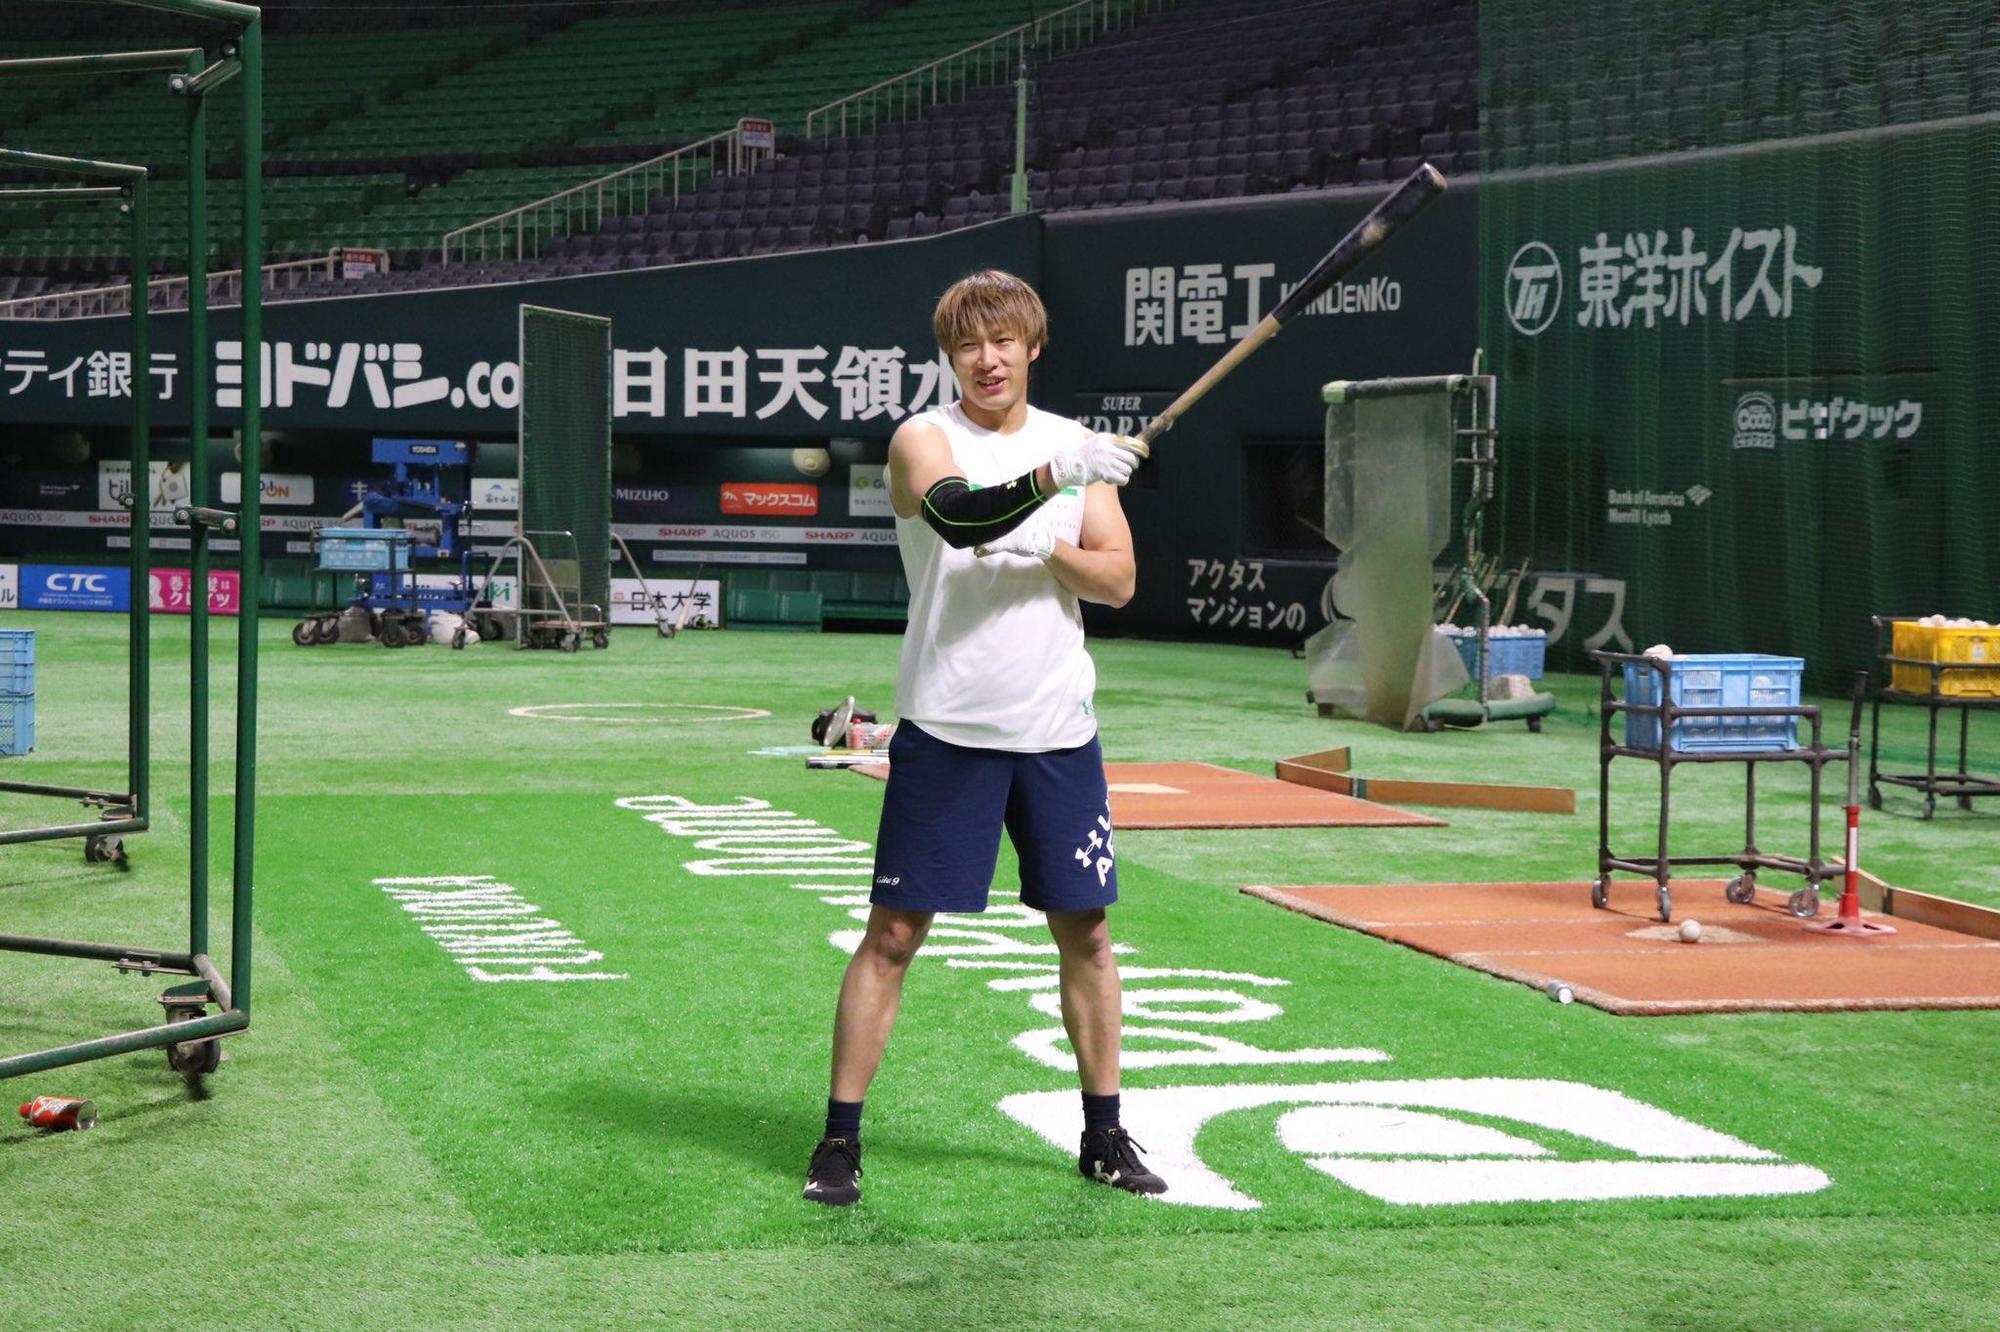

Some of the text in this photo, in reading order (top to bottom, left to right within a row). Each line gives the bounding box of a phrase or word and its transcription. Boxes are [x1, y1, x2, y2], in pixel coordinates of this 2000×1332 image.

[1577, 225, 1823, 328] 東洋ホイスト
[1125, 263, 1276, 346] 関電工
[613, 345, 962, 421] 日田天領水
[1102, 396, 1142, 411] SUPER
[1782, 396, 1923, 439] ピザクック
[615, 488, 669, 502] MIZUHO
[743, 492, 816, 508] マックスコム
[1608, 489, 1632, 504] Bank
[1, 512, 42, 523] AQUOS
[658, 528, 707, 538] SHARP
[713, 529, 756, 540] AQUOS
[804, 531, 855, 541] SHARP
[861, 532, 897, 543] AQUO
[46, 573, 108, 592] CTC
[1187, 559, 1266, 593] アクタス
[631, 591, 711, 612] 日本大学
[1187, 598, 1307, 633] マンションの
[371, 875, 630, 982] FUKUOKA
